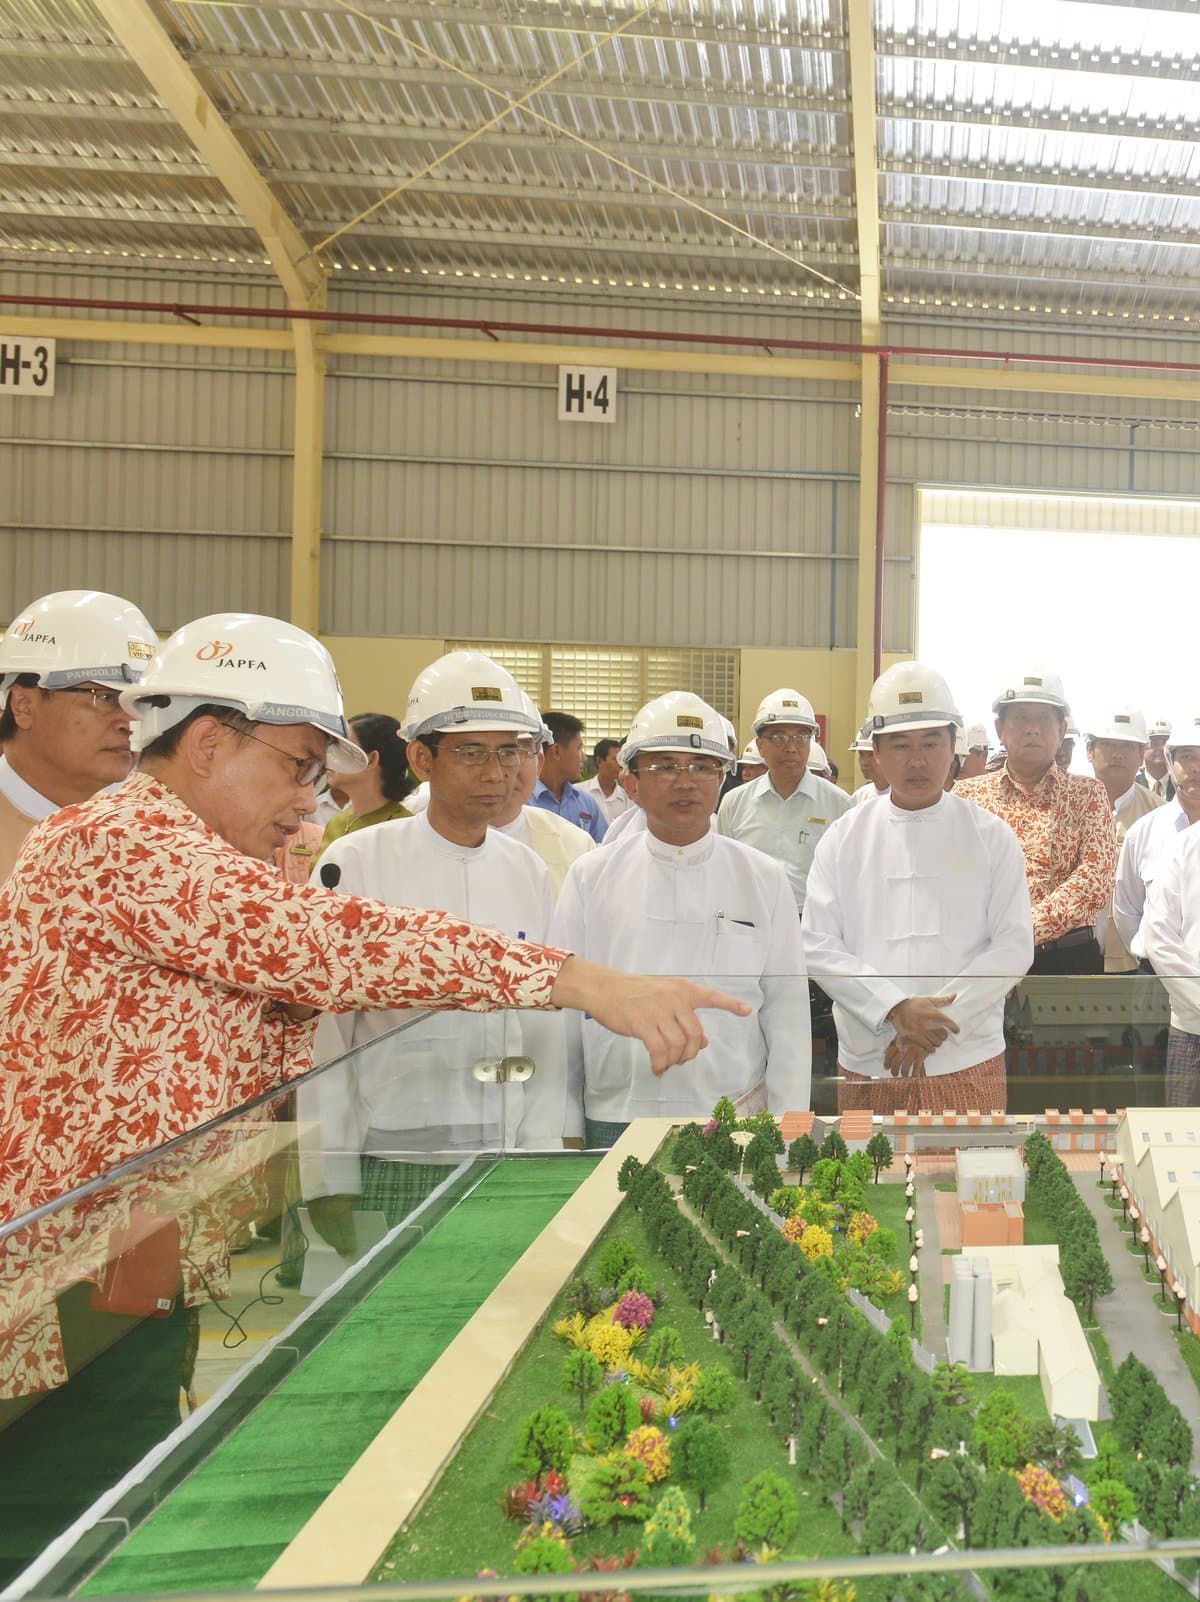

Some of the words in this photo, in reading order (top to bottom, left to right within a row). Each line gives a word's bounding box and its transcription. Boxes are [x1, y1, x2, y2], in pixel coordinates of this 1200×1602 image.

[0, 343, 48, 387] H-3
[566, 373, 609, 414] H-4
[23, 633, 56, 645] JAPFA
[216, 658, 267, 670] JAPFA
[65, 667, 122, 681] PANGOLIN
[257, 705, 320, 720] PANGOLIN
